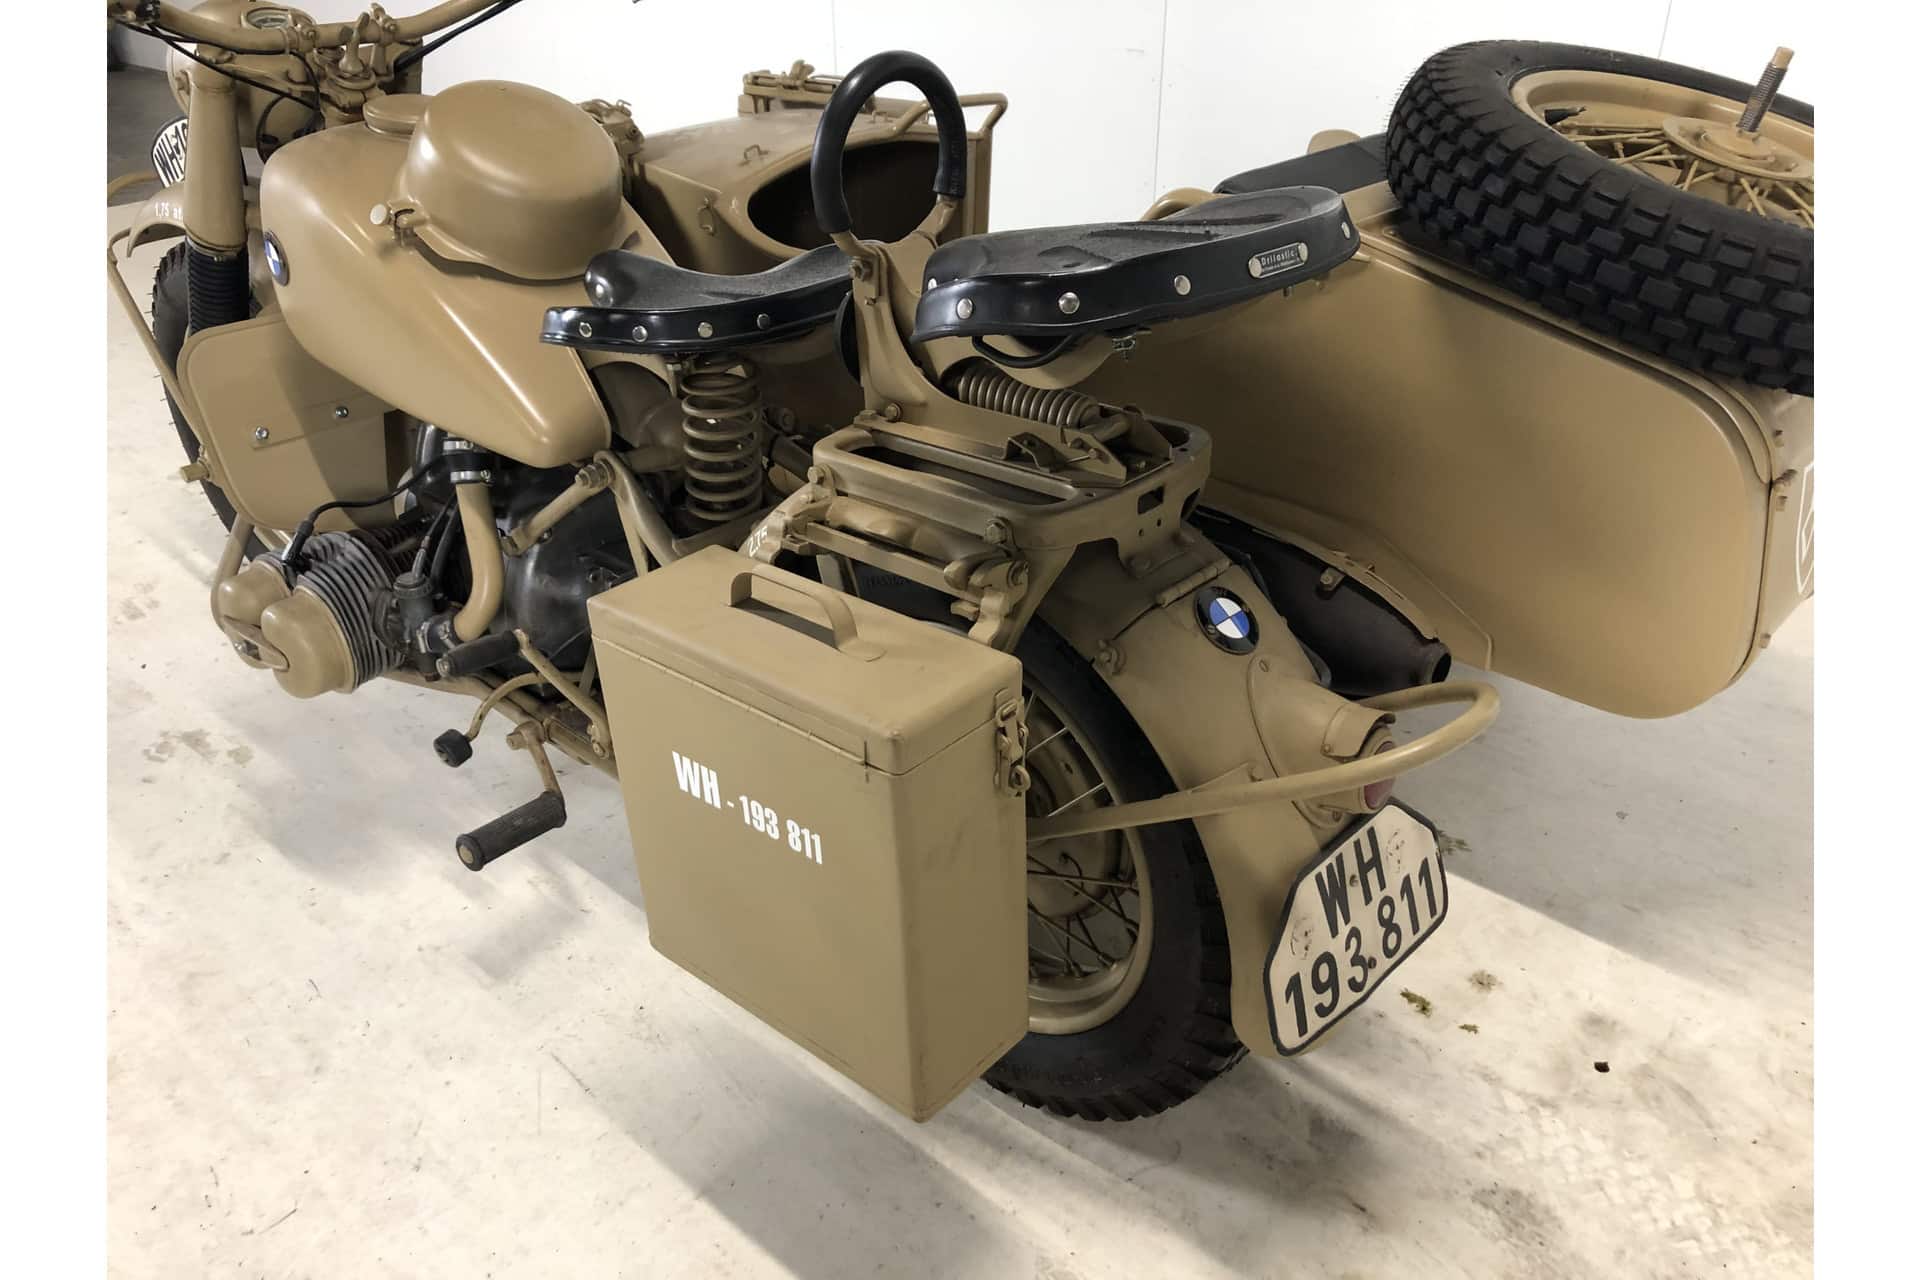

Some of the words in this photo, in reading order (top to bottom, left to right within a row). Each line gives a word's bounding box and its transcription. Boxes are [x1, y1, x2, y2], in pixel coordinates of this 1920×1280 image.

[672, 750, 722, 809] WH
[739, 795, 780, 840] 193
[786, 818, 823, 865] 811
